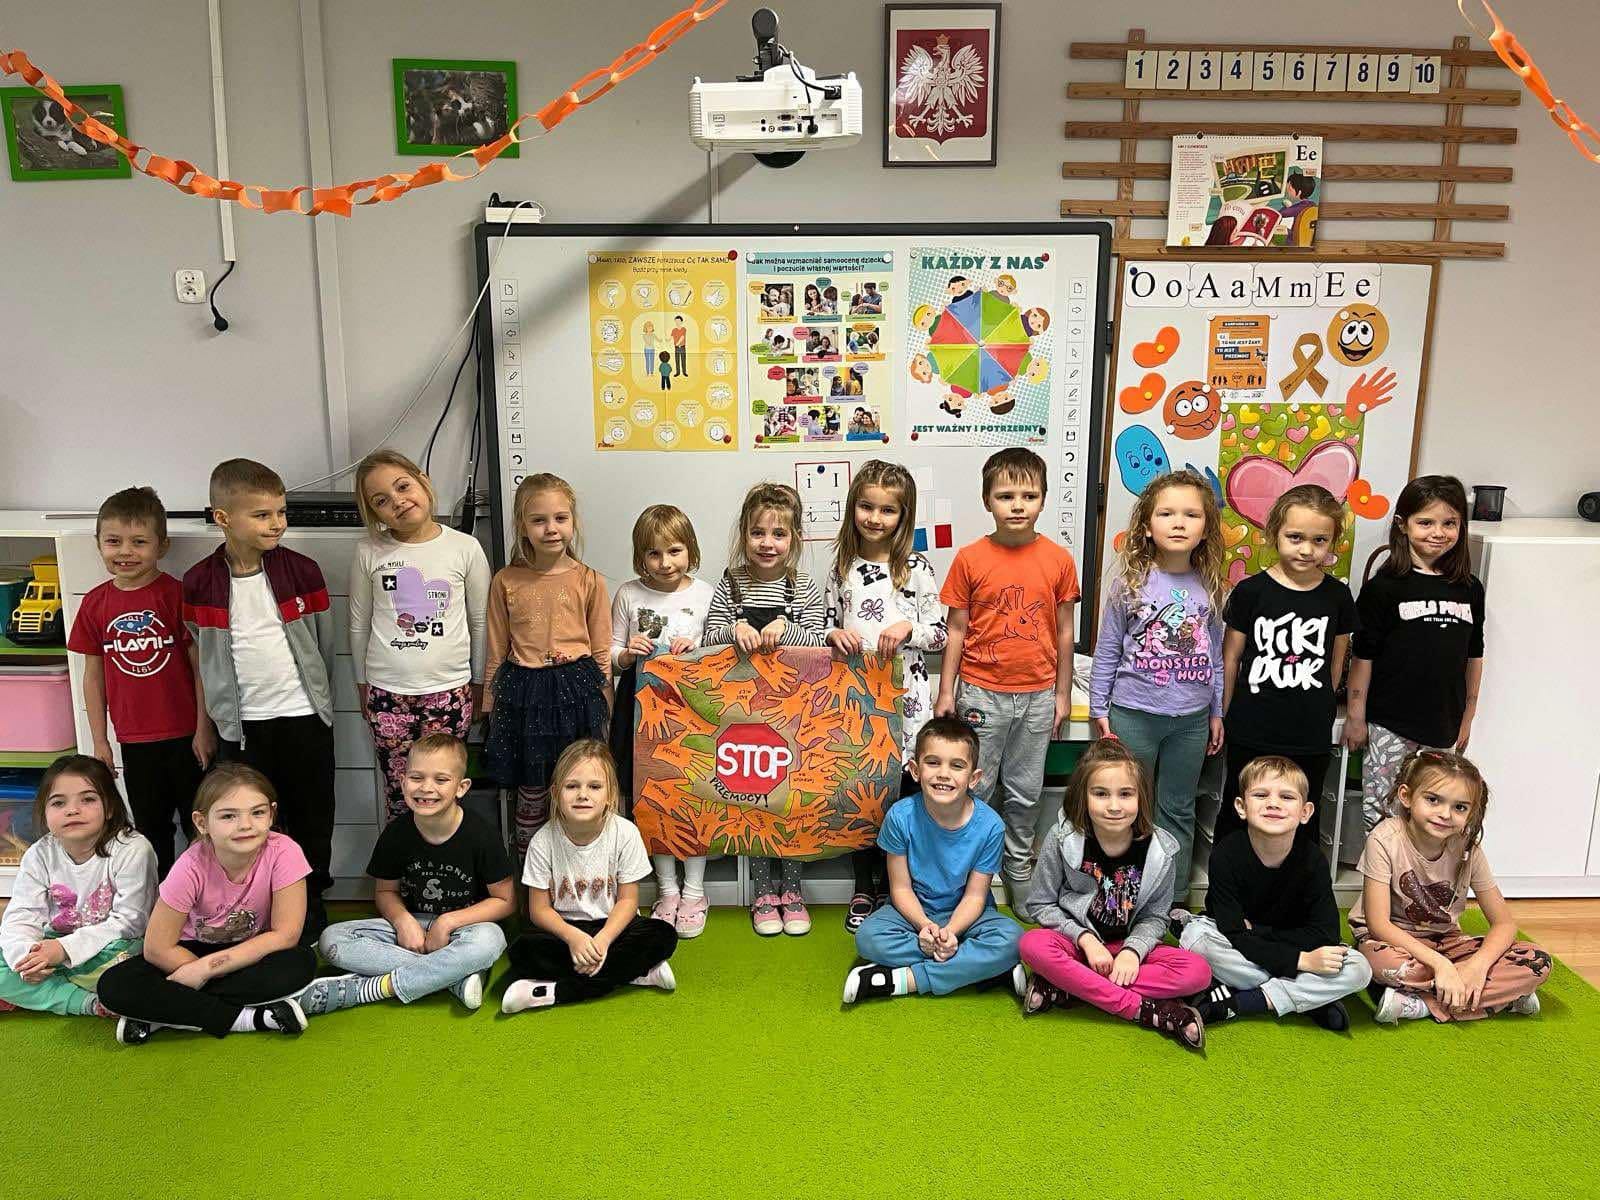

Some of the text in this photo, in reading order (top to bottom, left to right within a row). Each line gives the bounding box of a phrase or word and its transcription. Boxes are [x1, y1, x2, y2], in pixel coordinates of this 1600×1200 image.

[1135, 59, 1435, 84] 1 2 3 4 5 6 7 8 9 10
[1296, 145, 1318, 161] Ee
[922, 253, 1044, 270] KAŻDY Z NAS
[912, 425, 934, 433] JEST
[936, 424, 972, 433] WAŻNY
[1136, 656, 1212, 685] MONSTER HUG!
[716, 742, 794, 779] STOP
